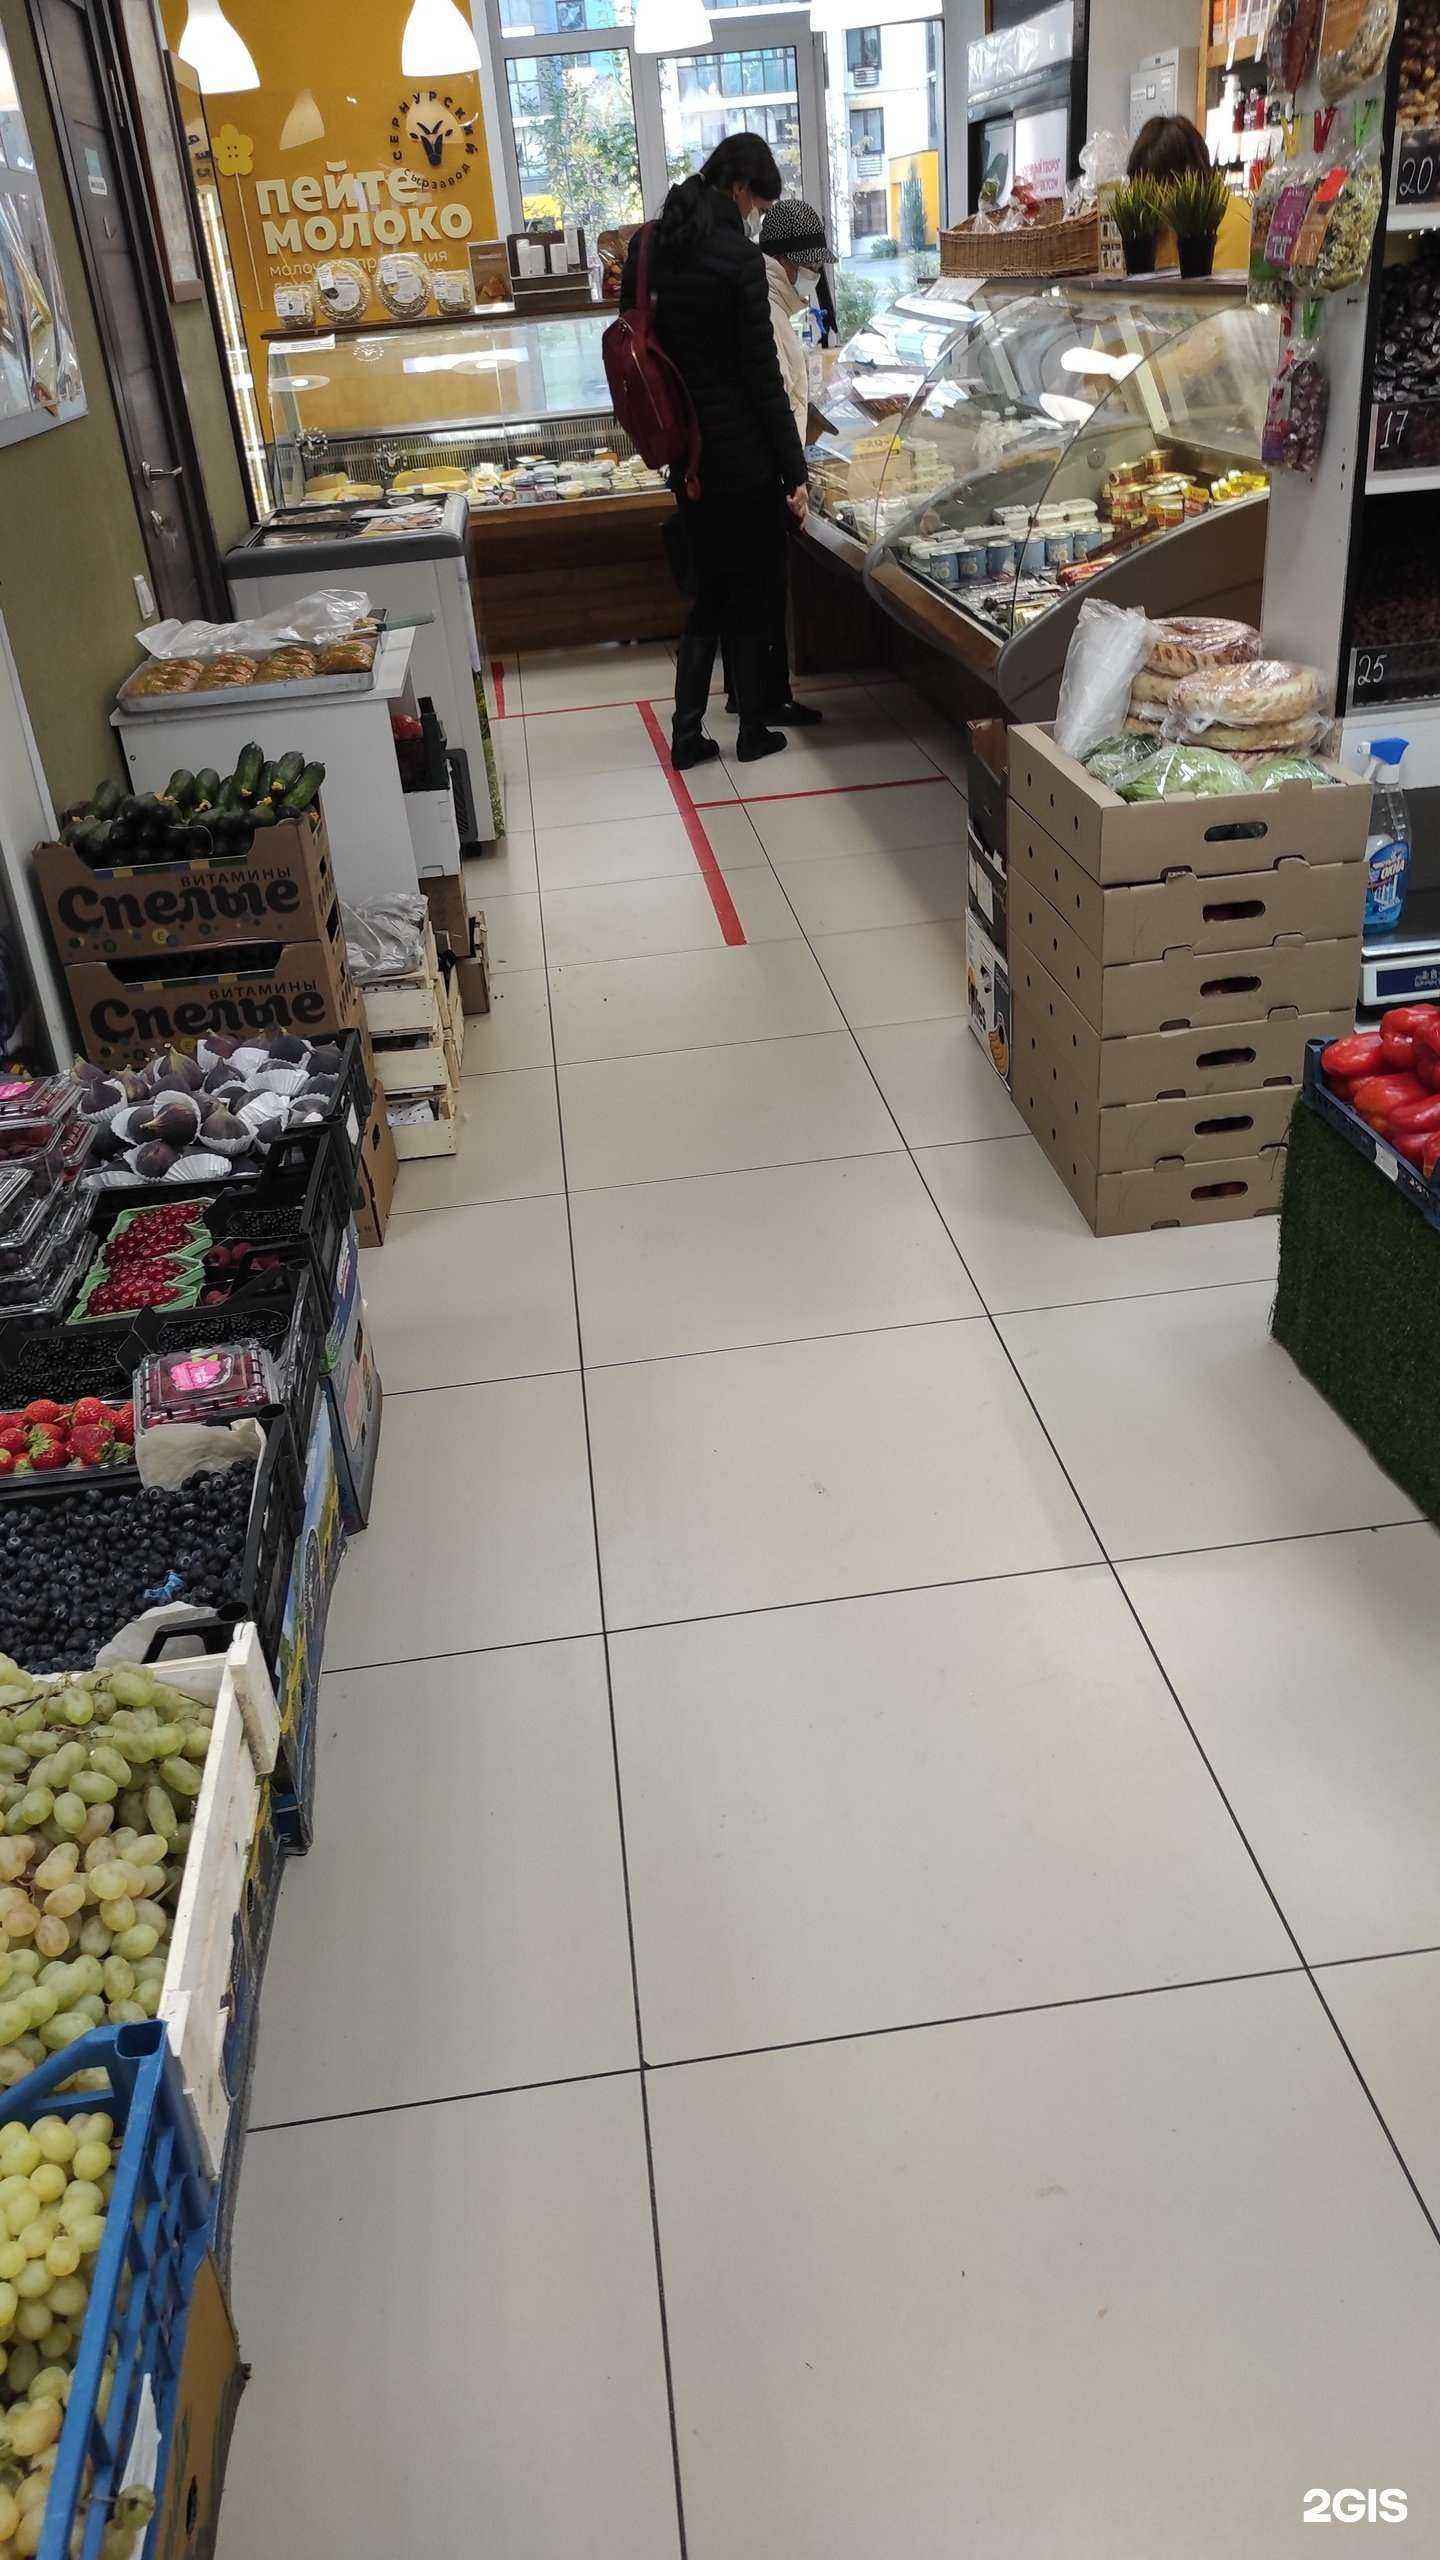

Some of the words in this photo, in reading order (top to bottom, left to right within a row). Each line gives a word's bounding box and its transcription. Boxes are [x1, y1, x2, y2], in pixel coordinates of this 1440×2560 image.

[389, 90, 478, 161] СЕРНУРСКИЙ
[256, 160, 420, 215] пейте
[1400, 156, 1434, 195] 20
[262, 203, 473, 255] молоко
[1380, 409, 1409, 449] 17
[1358, 654, 1388, 685] 25
[181, 866, 291, 887] ВИТАМИНЫ
[58, 879, 301, 932] Спелые
[209, 980, 317, 1000] ВИТАМИНЫ
[90, 992, 326, 1043] Спелые
